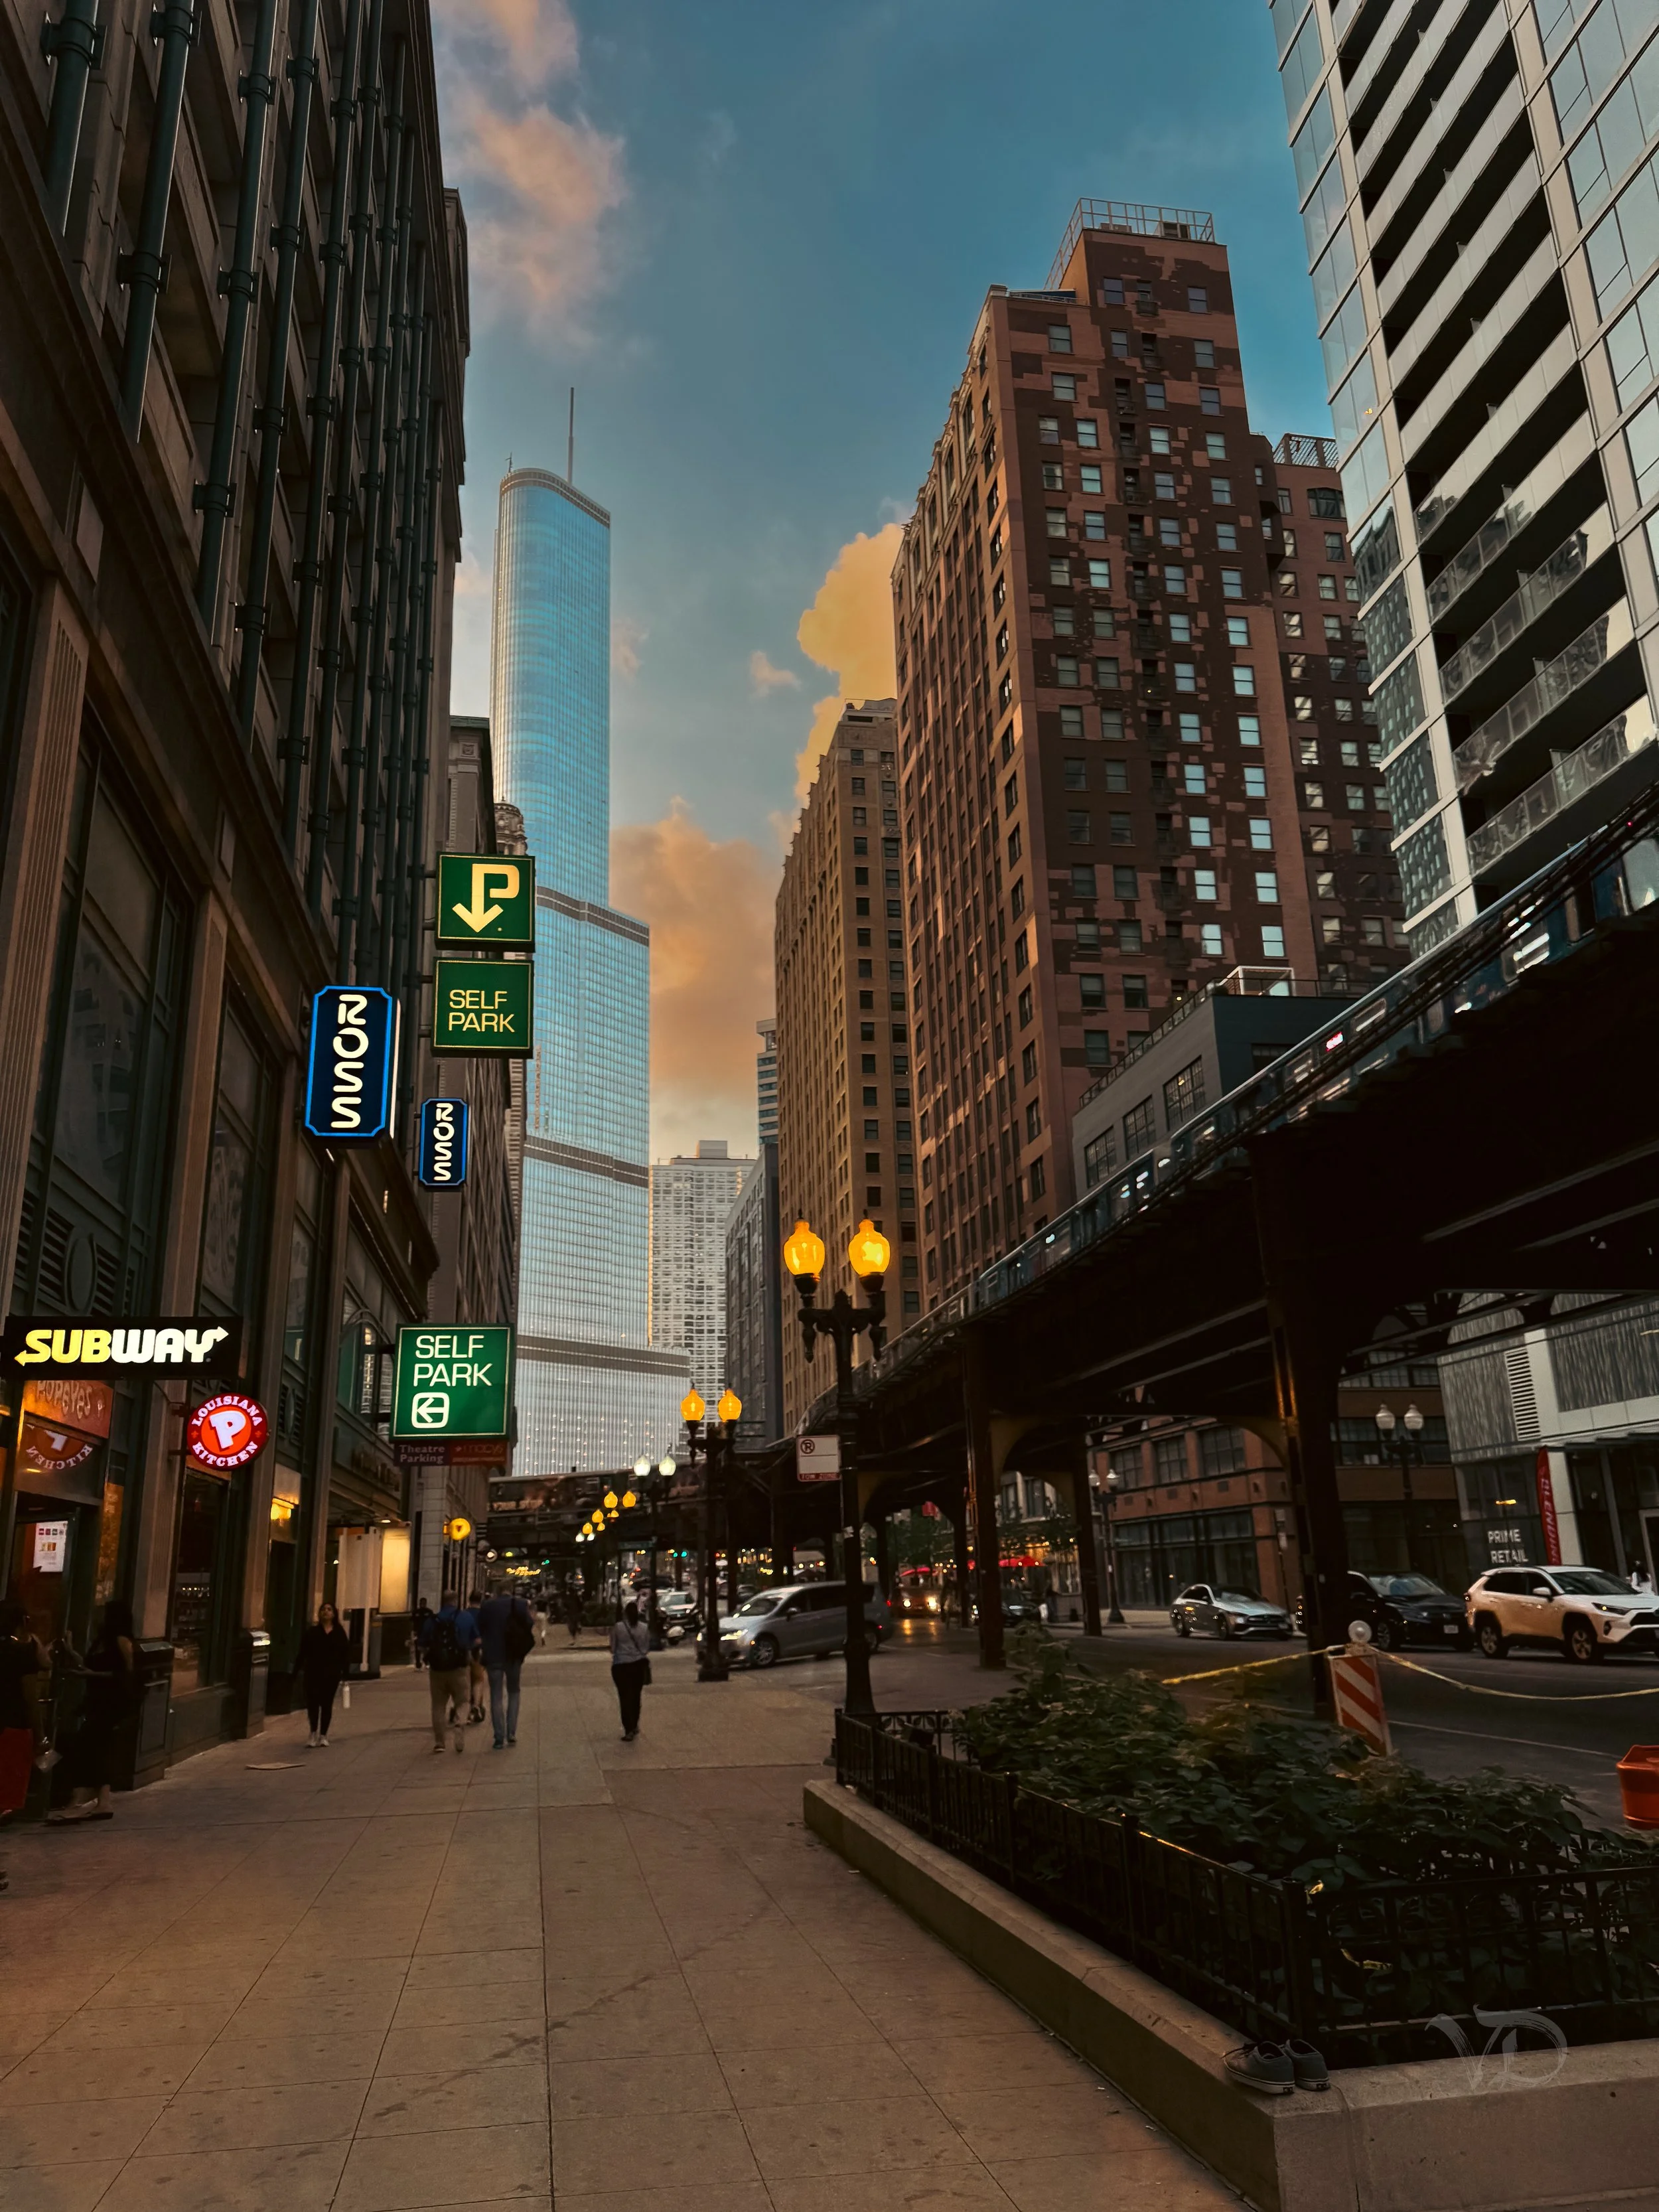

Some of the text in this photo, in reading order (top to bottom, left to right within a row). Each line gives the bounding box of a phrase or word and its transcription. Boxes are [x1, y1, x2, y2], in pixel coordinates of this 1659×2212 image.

[452, 863, 520, 932] P
[449, 989, 507, 1009] SELF
[448, 1012, 515, 1033] PARK
[330, 994, 368, 1128] ROSS
[433, 1102, 455, 1181] ROSS
[15, 1326, 228, 1366] SUBWAY
[415, 1335, 484, 1359] SELF
[413, 1363, 492, 1387] PARK
[191, 1396, 263, 1426] LOUISIANA
[209, 1410, 246, 1449] P
[192, 1441, 258, 1467] KITCHEN
[399, 1444, 445, 1453] Theatre
[400, 1453, 444, 1465] Parking
[1487, 1529, 1521, 1544] PRIME
[1490, 1549, 1529, 1564] RETAIL
